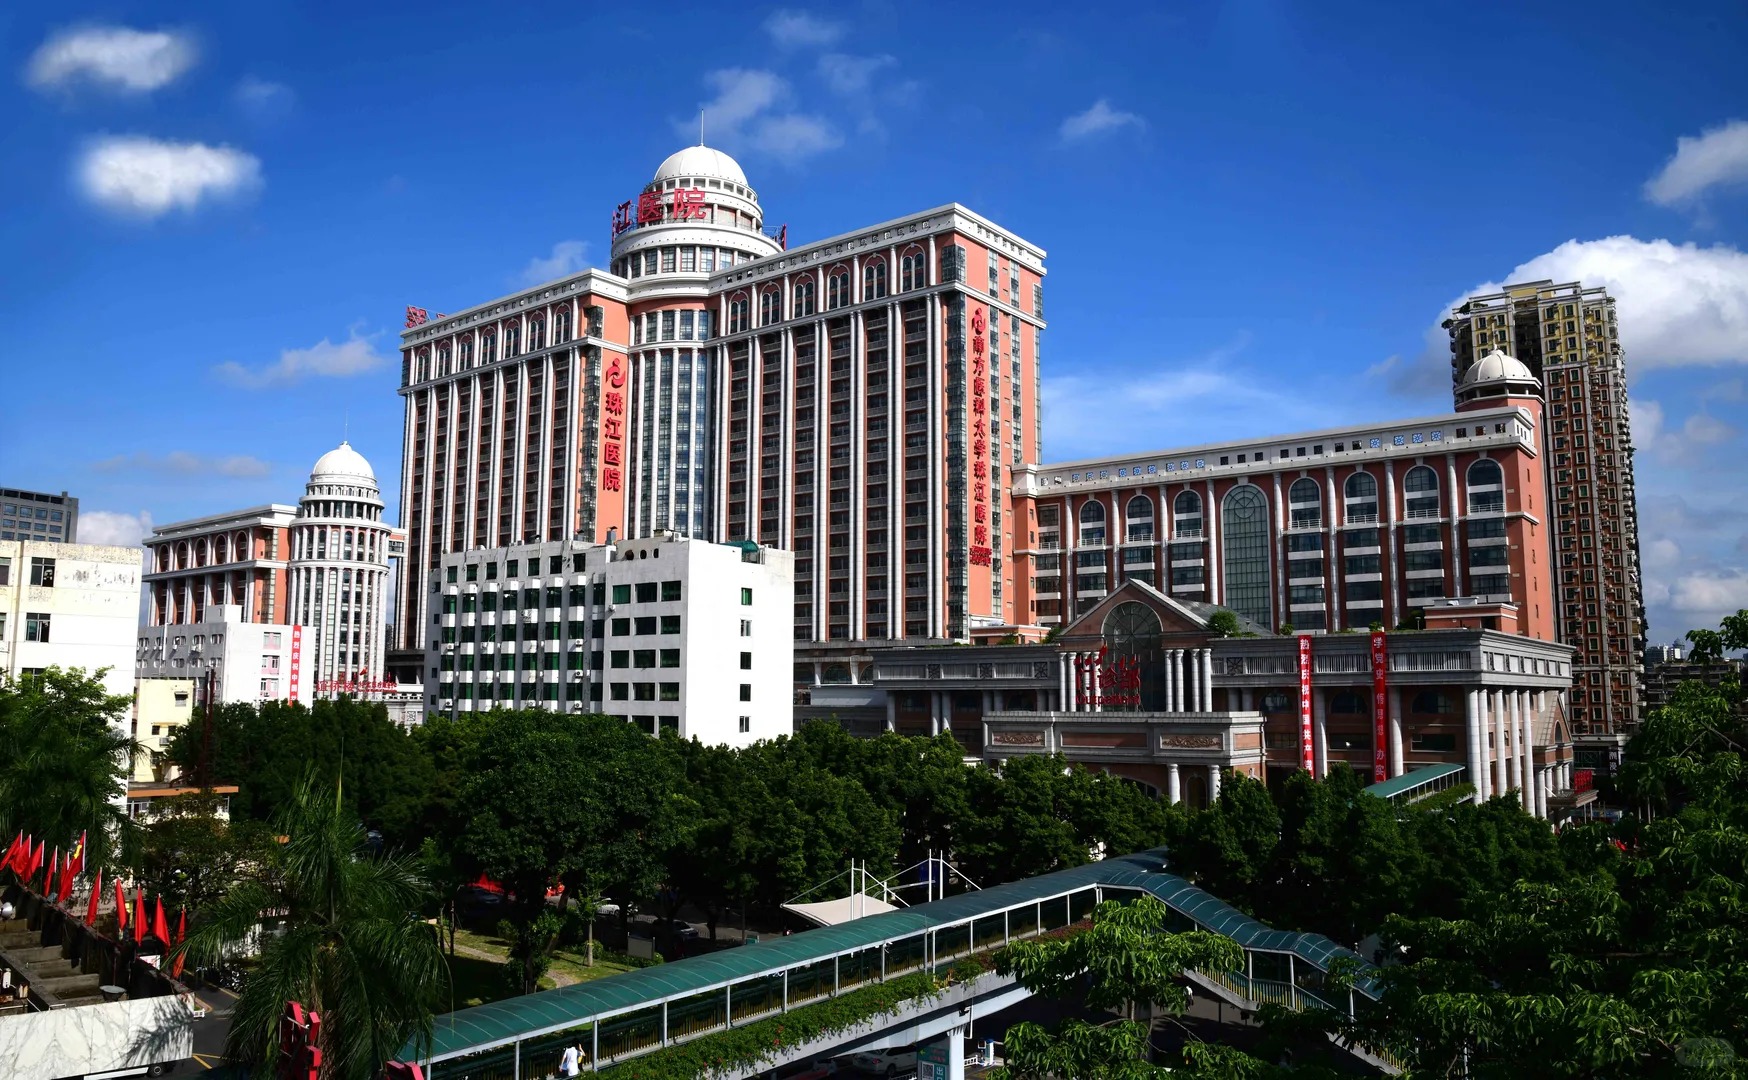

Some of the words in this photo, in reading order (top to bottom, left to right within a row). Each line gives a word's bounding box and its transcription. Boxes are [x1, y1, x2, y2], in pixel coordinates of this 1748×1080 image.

[611, 187, 706, 246] 江医院
[603, 391, 623, 492] 珠江医院
[972, 335, 987, 546] 南方医科大学珠江医院
[1076, 662, 1140, 689] 门诊部
[1300, 638, 1314, 778] 热烈庆祝中国共产党
